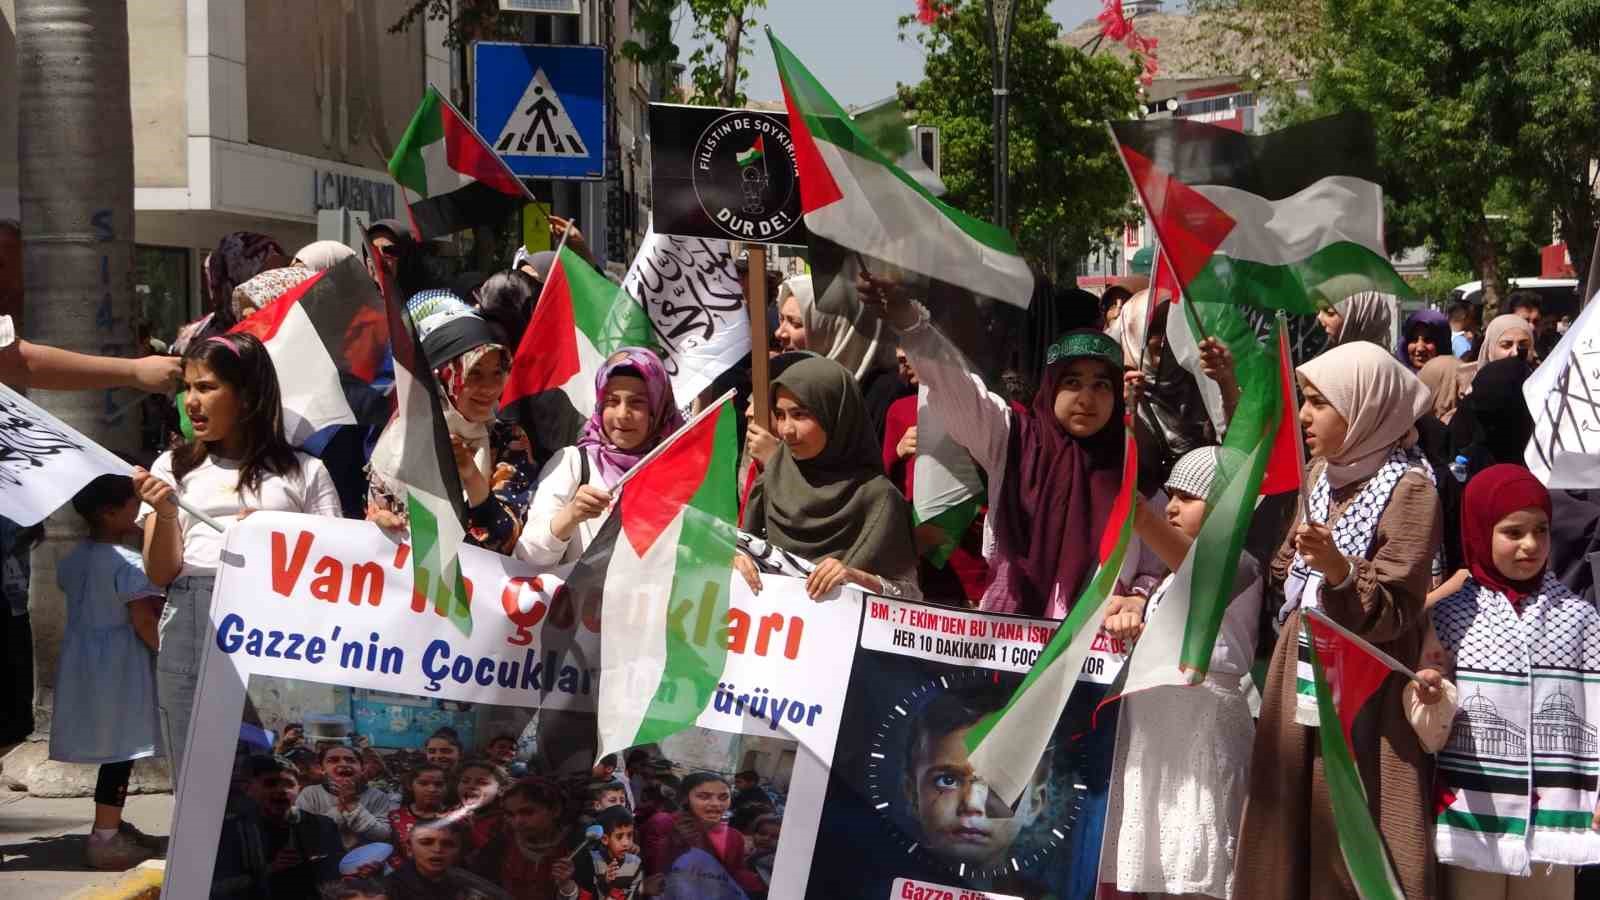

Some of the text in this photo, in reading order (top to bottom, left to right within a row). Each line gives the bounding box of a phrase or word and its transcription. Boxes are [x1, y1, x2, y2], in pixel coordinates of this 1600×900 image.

[716, 207, 792, 236] DUR DE!
[501, 576, 804, 660] Çockları
[870, 601, 889, 619] BM
[899, 608, 906, 624] 7
[910, 609, 965, 636] EKİM'DEN
[970, 620, 987, 638] BU
[990, 622, 1023, 641] YANA
[892, 628, 916, 648] HER
[919, 634, 933, 653] 10
[936, 638, 996, 661] DAKİKADA
[1002, 645, 1008, 663] 1
[216, 613, 404, 674] Gazze'nin
[421, 639, 600, 696] Çocuklar
[694, 681, 823, 730] ürüyor
